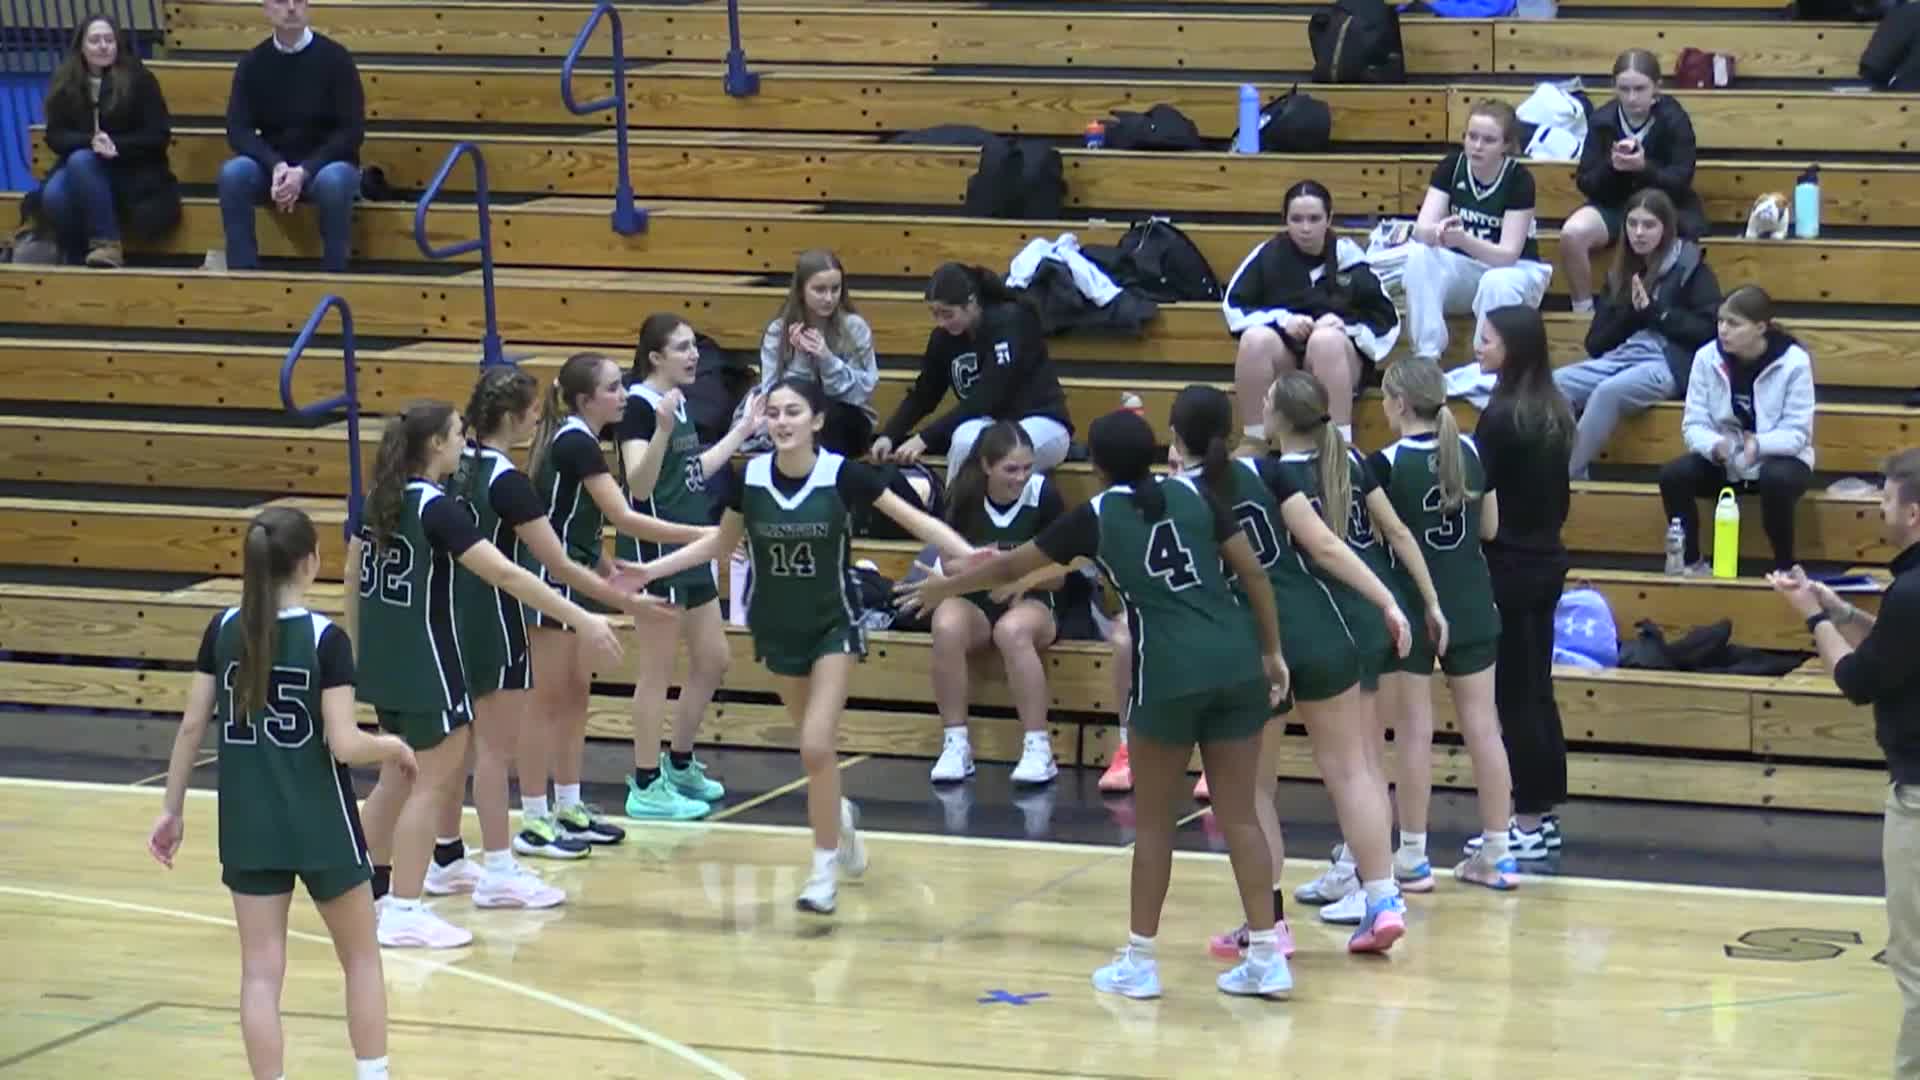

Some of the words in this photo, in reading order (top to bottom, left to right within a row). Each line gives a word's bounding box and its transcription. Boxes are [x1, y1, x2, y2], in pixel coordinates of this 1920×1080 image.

[360, 525, 415, 607] 32
[769, 543, 816, 576] 14
[1144, 519, 1202, 592] 4
[224, 661, 314, 748] 15
